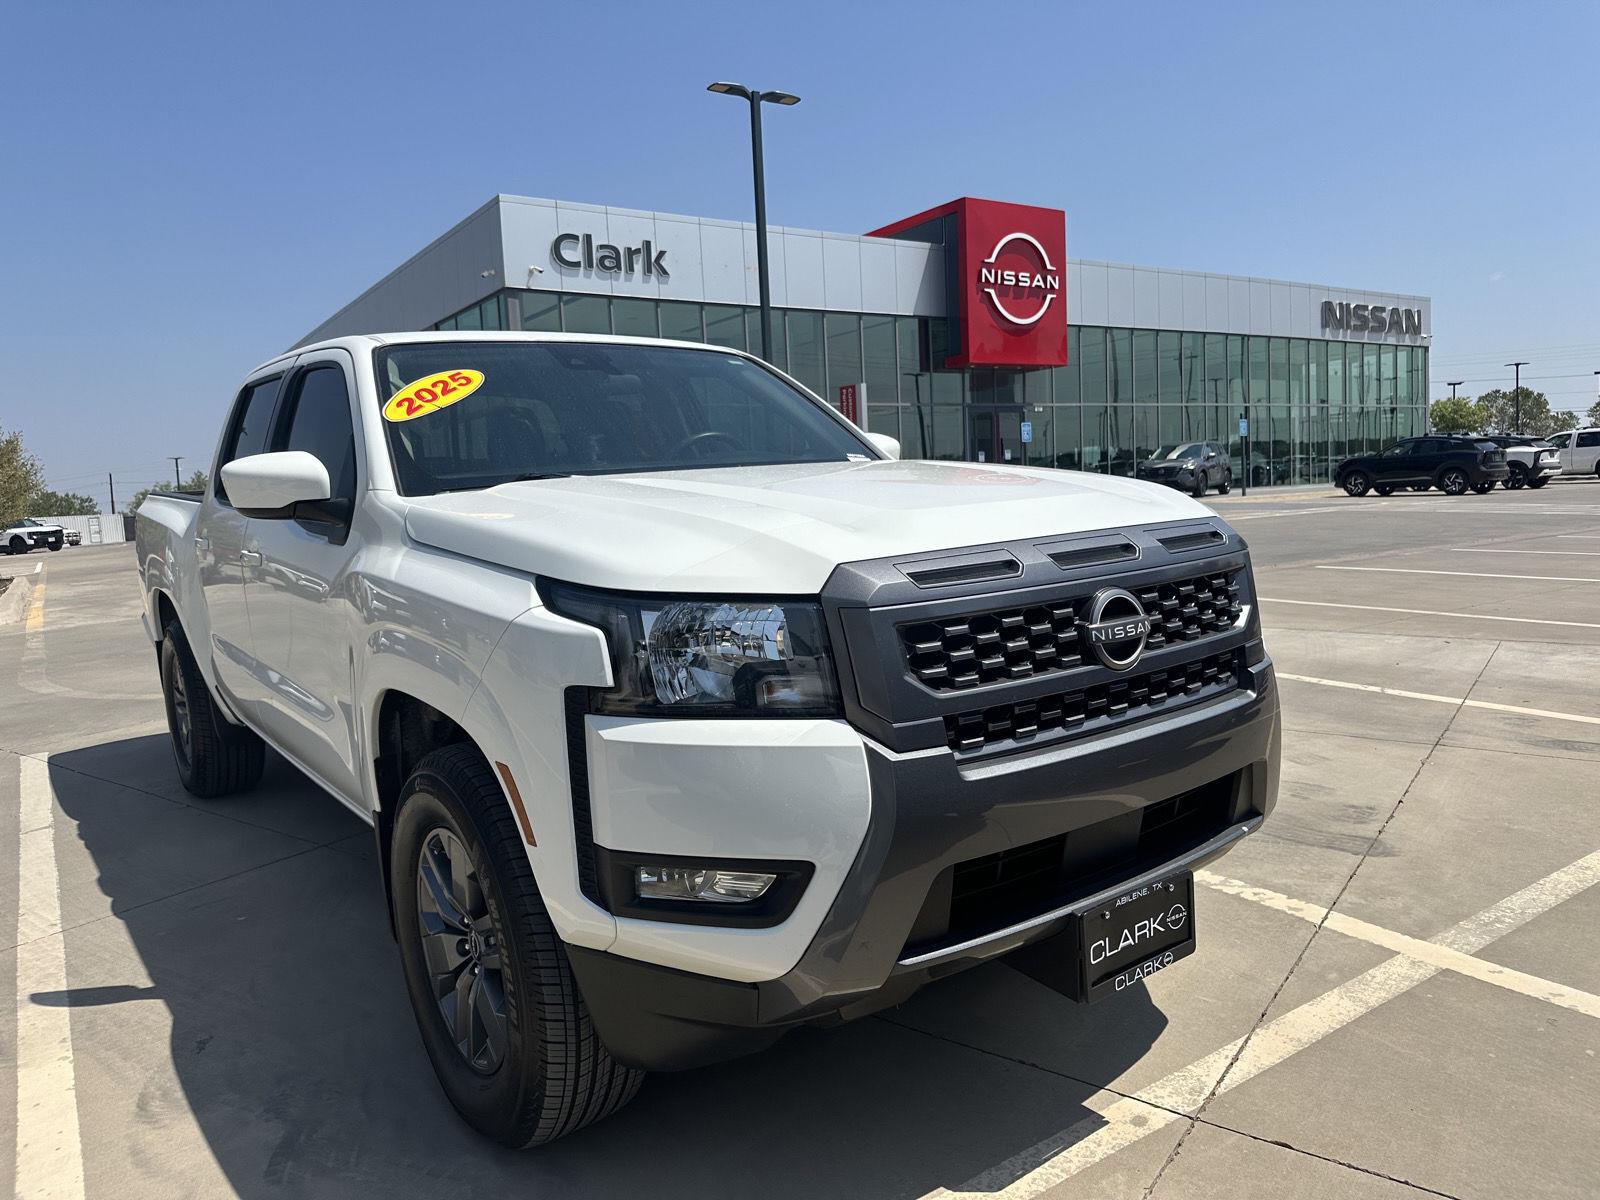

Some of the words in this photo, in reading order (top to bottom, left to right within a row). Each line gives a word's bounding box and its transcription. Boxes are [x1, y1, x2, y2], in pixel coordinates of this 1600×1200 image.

[552, 233, 670, 277] Clark
[981, 267, 1059, 290] NISSAN
[1321, 301, 1421, 335] NISSAN
[396, 372, 472, 416] 2025
[1092, 621, 1151, 641] NISSAN
[1152, 882, 1163, 891] TX
[1090, 912, 1165, 965] CLARK
[1166, 911, 1188, 923] NISSAN
[489, 897, 518, 1029] MICHELIN
[1115, 957, 1163, 991] CLARK
